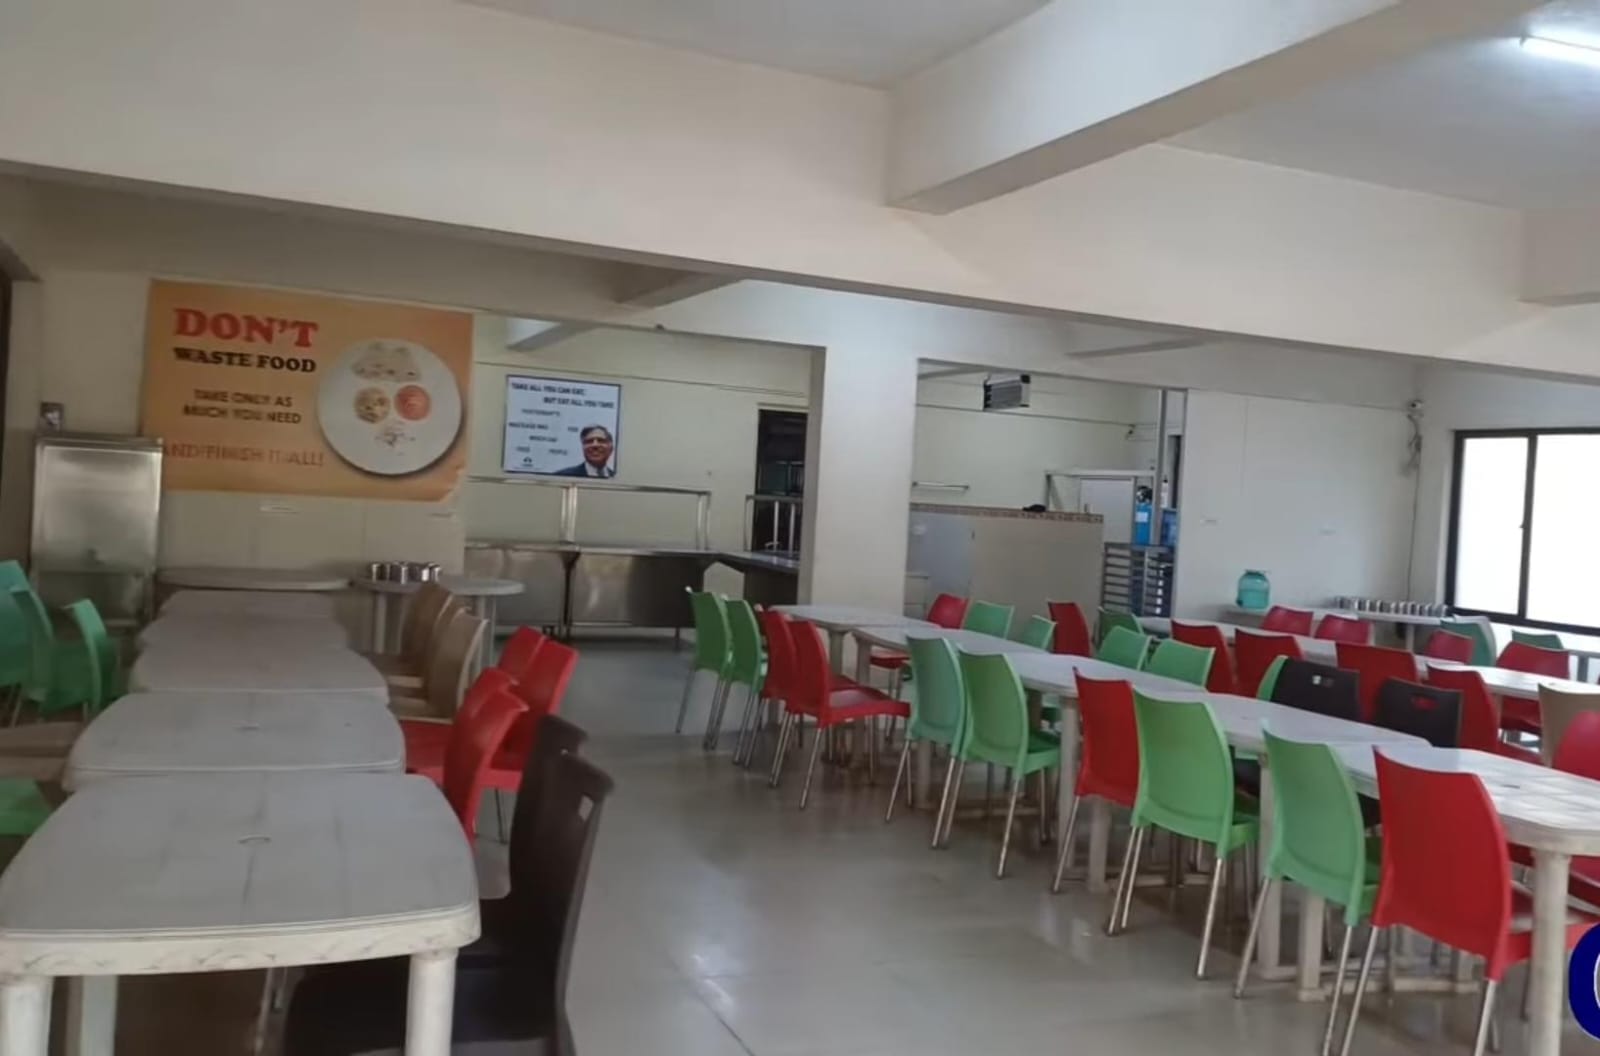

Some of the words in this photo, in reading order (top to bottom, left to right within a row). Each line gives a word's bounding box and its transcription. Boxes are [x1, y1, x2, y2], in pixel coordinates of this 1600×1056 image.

[173, 307, 319, 348] DON'T
[173, 347, 251, 368] WASTE
[256, 354, 317, 373] FOOD
[193, 389, 228, 403] TAKE
[274, 395, 293, 408] AS
[183, 404, 227, 419] MUCH
[232, 408, 264, 421] YOU
[267, 411, 302, 425] NEED
